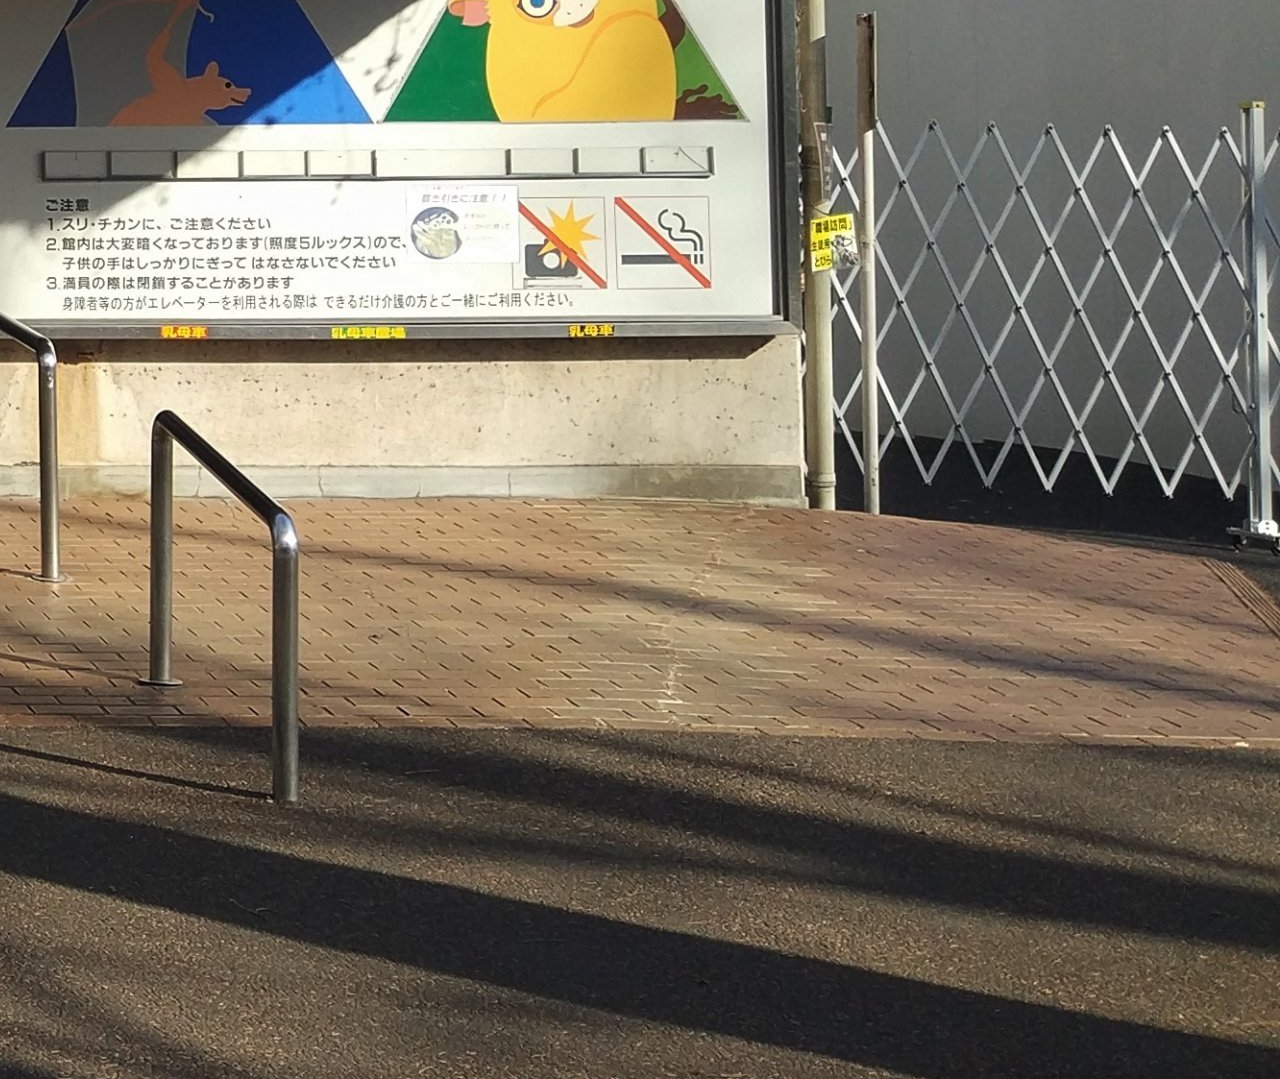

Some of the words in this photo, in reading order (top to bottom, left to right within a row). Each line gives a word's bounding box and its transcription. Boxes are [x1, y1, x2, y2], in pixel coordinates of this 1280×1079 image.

[45, 198, 90, 213] ご注意
[160, 325, 207, 339] 乳母車
[569, 324, 614, 338] 乳母車
